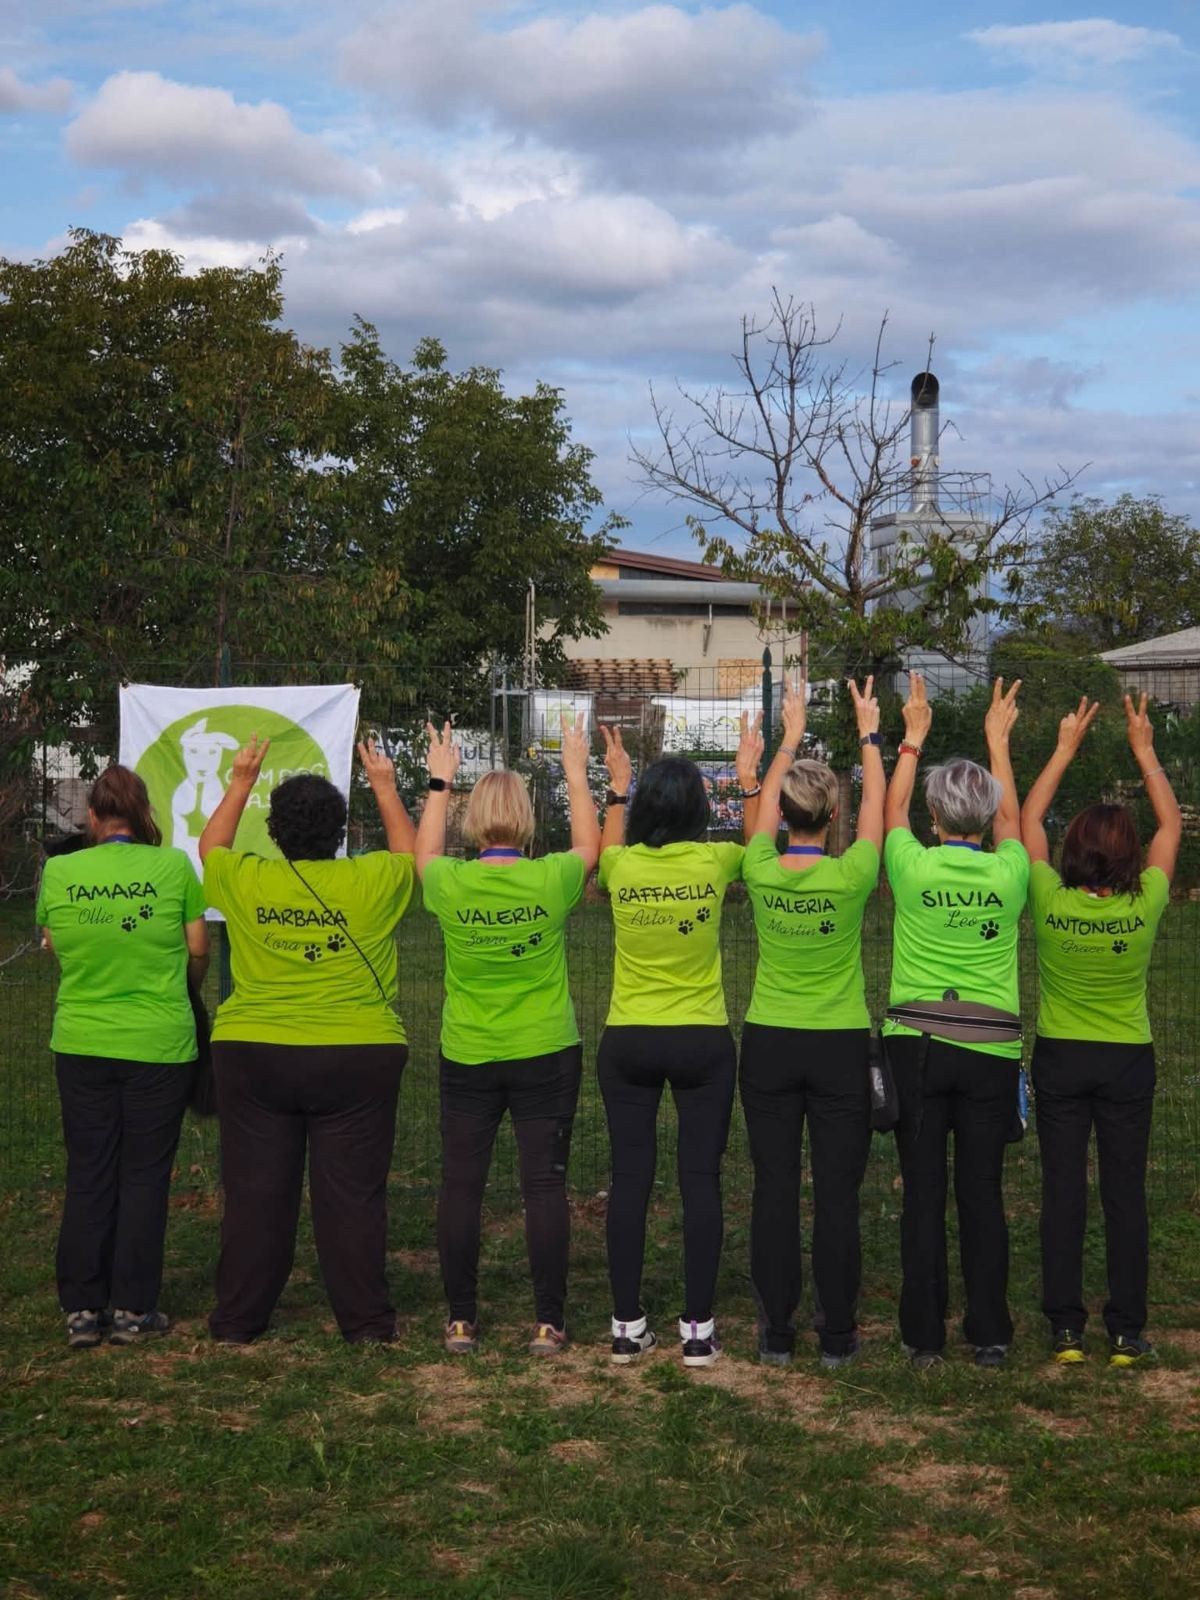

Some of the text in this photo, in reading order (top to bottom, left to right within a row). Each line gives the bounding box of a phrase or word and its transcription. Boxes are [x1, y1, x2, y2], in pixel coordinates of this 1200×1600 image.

[66, 881, 158, 903] TAMARA
[618, 883, 717, 904] RAFFAELLA
[921, 890, 1004, 909] SILVIA
[456, 904, 549, 926] VALERIA
[763, 895, 837, 915] VALERIA
[78, 906, 114, 926] Ollie
[256, 906, 349, 928] BARBARA
[630, 908, 675, 927] Astor
[944, 910, 978, 929] Leo
[1045, 913, 1146, 936] ANTONELLA
